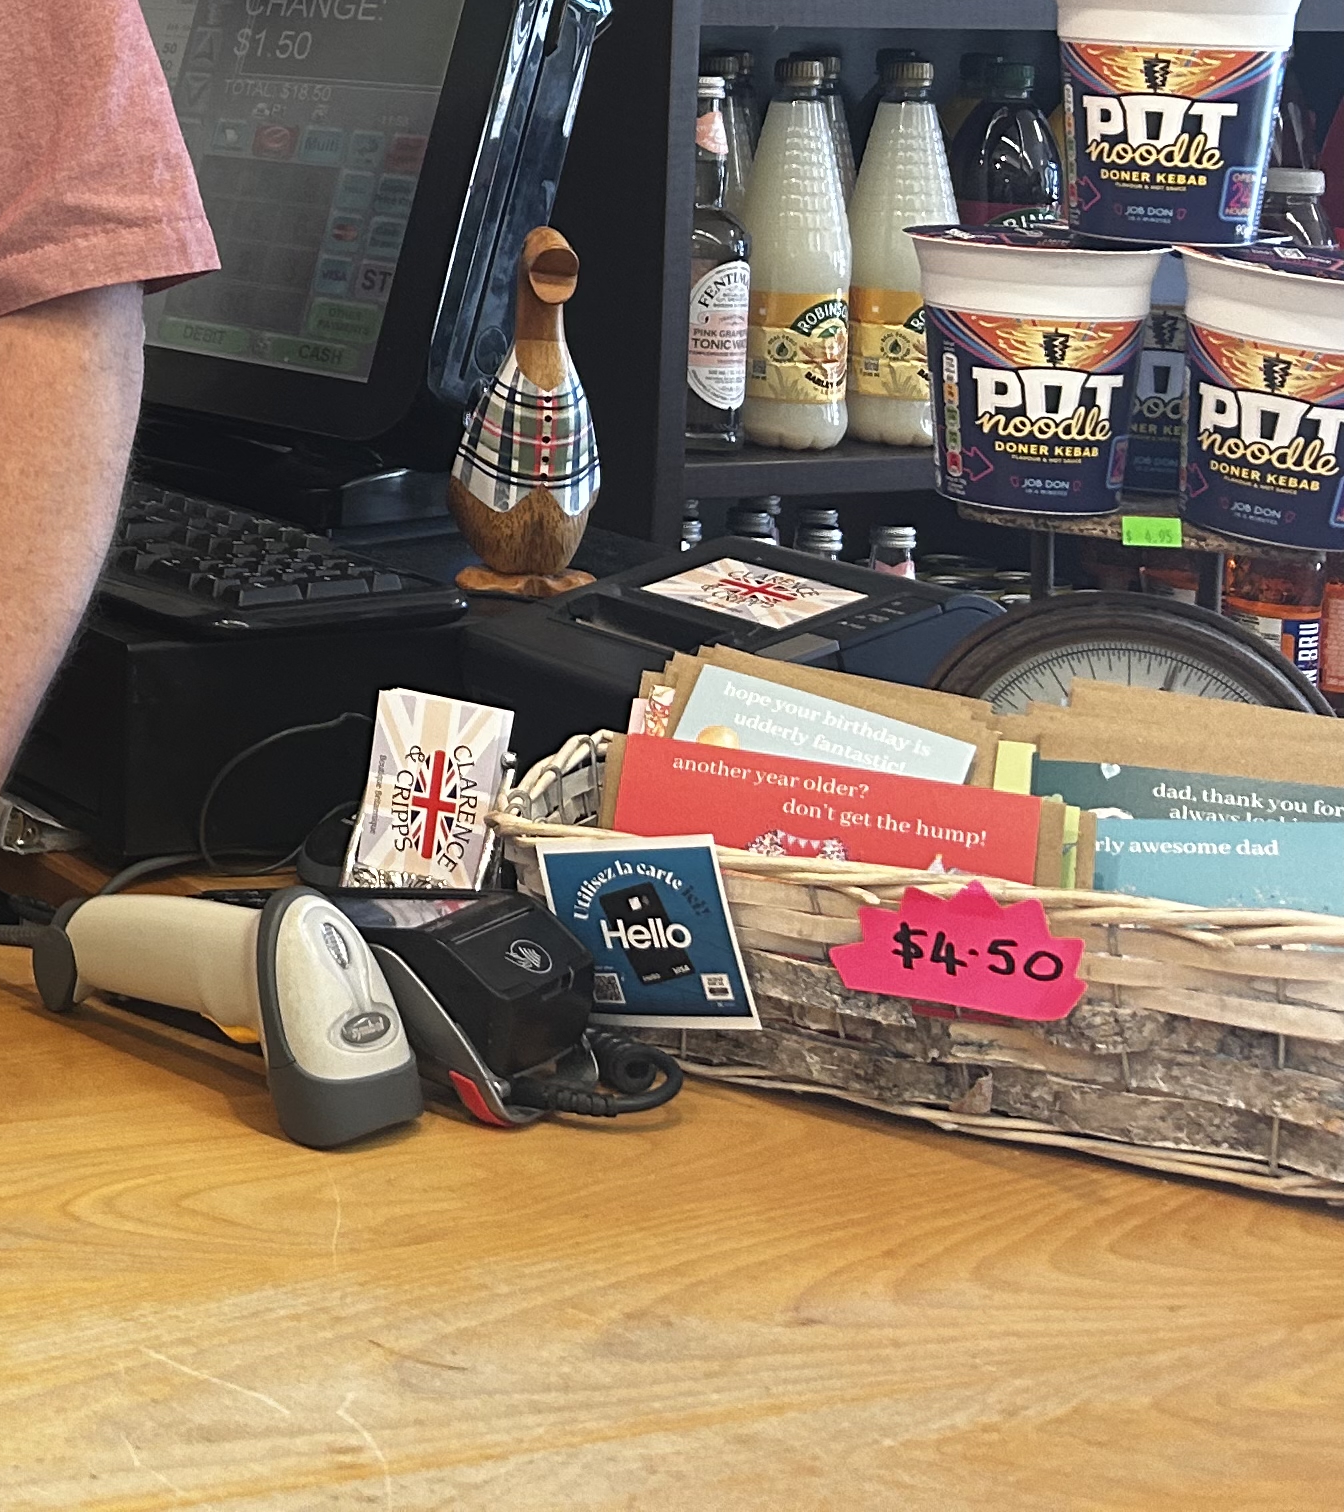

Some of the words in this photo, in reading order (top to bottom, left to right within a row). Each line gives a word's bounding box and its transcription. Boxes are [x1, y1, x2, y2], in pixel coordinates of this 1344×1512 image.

[233, 27, 313, 60] $1.50
[1082, 94, 1238, 150] POT
[1085, 133, 1225, 170] noodle
[1100, 169, 1150, 183] DONER
[1156, 172, 1208, 186] KEBAB
[1124, 205, 1145, 217] JOB
[1147, 207, 1174, 218] DON
[182, 326, 227, 345] DEBIT
[692, 338, 731, 350] TONIC
[693, 329, 719, 338] PINK
[298, 344, 343, 364] CASH
[972, 366, 1124, 422] POT
[976, 406, 1112, 441] noodle
[1198, 382, 1344, 457] POT
[994, 440, 1050, 456] DONER
[1054, 445, 1099, 458] KEBAB
[1198, 428, 1340, 477] noodle
[1022, 477, 1043, 489] JOB
[1045, 479, 1070, 490] DON
[1209, 458, 1262, 482] DONER
[1266, 472, 1321, 492] KEBAB
[1230, 501, 1252, 514] JOB
[1254, 505, 1282, 519] DON
[1297, 623, 1319, 662] BRU
[723, 681, 771, 709] hope
[772, 698, 821, 723] your
[822, 709, 909, 756] birthday
[912, 733, 932, 758] is
[404, 744, 426, 763] &
[733, 709, 808, 746] udderly
[811, 735, 907, 774] fantastic!
[672, 755, 751, 785] another
[754, 770, 800, 793] year
[803, 776, 870, 799] older?
[390, 769, 416, 853] CRIPPS
[437, 744, 479, 873] CLARENCE
[1202, 788, 1263, 808] thank
[1268, 796, 1307, 814] you
[1313, 798, 1344, 818] for
[782, 798, 836, 822] don't
[840, 808, 872, 829] get
[876, 813, 911, 834] the
[915, 820, 987, 849] hump!
[1129, 840, 1231, 856] awesome
[1235, 839, 1280, 856] dad
[573, 866, 617, 921] Utilisez
[614, 859, 633, 877] la
[636, 861, 683, 891] carte
[599, 917, 692, 950] Hello
[894, 922, 1065, 983] $4.50
